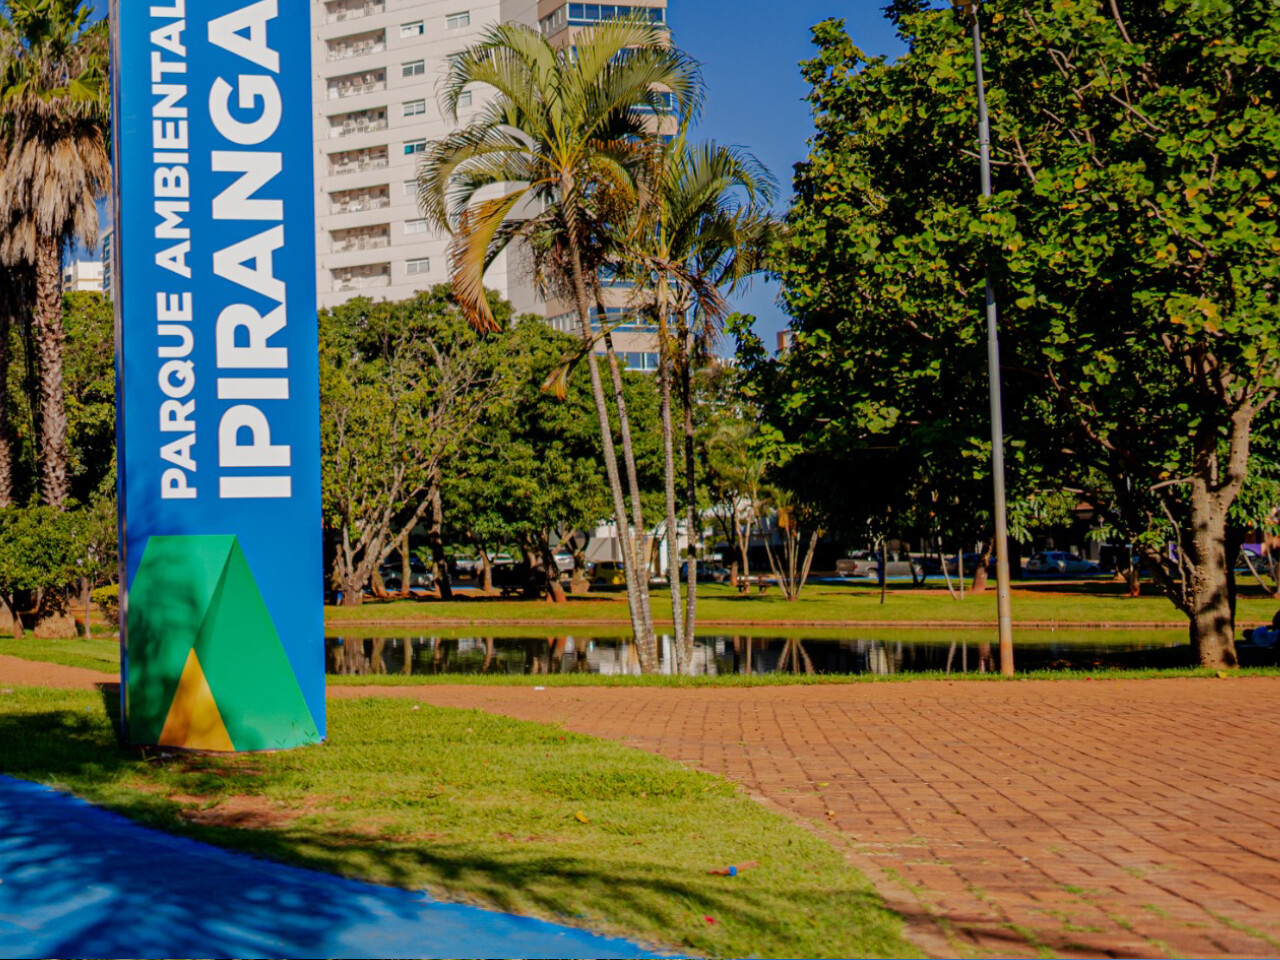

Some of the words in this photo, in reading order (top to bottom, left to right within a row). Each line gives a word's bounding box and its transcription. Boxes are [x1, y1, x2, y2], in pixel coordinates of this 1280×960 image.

[150, 0, 191, 279] AMBIENTAL
[207, 0, 291, 498] IPIRANGA
[156, 292, 197, 499] PARQUE
